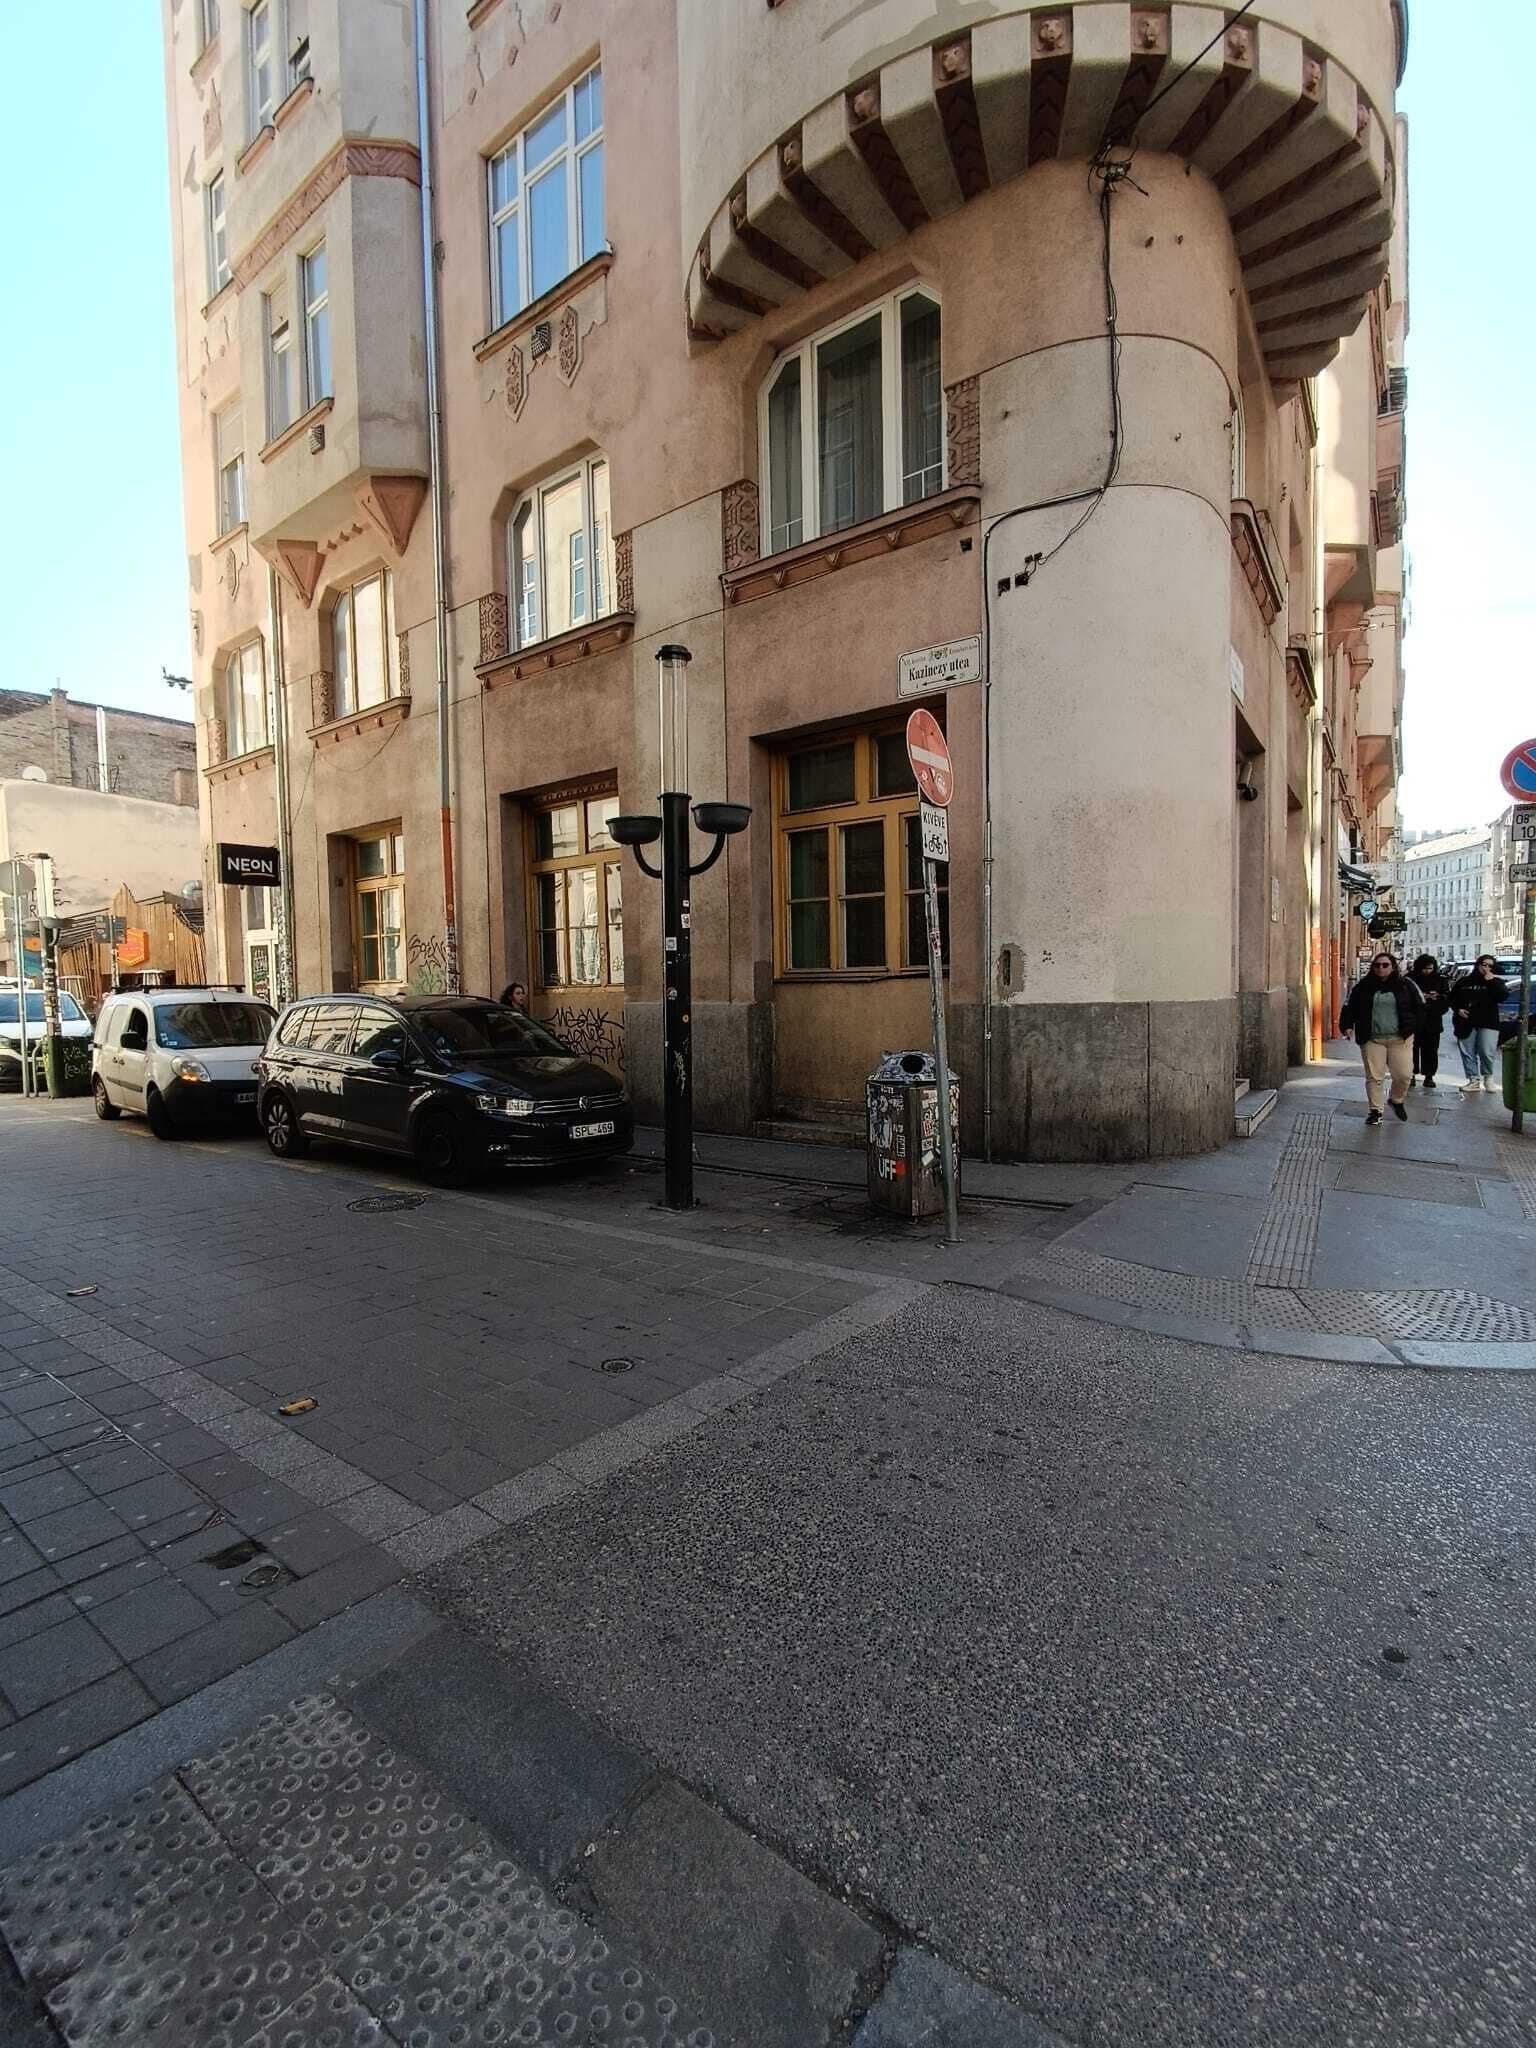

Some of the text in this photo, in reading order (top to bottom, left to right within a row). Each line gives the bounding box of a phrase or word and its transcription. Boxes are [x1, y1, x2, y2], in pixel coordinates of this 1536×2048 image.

[909, 662, 947, 681] Kazinczy
[949, 658, 970, 672] utca
[923, 811, 945, 829] KIVÉVE
[227, 857, 273, 873] NEON
